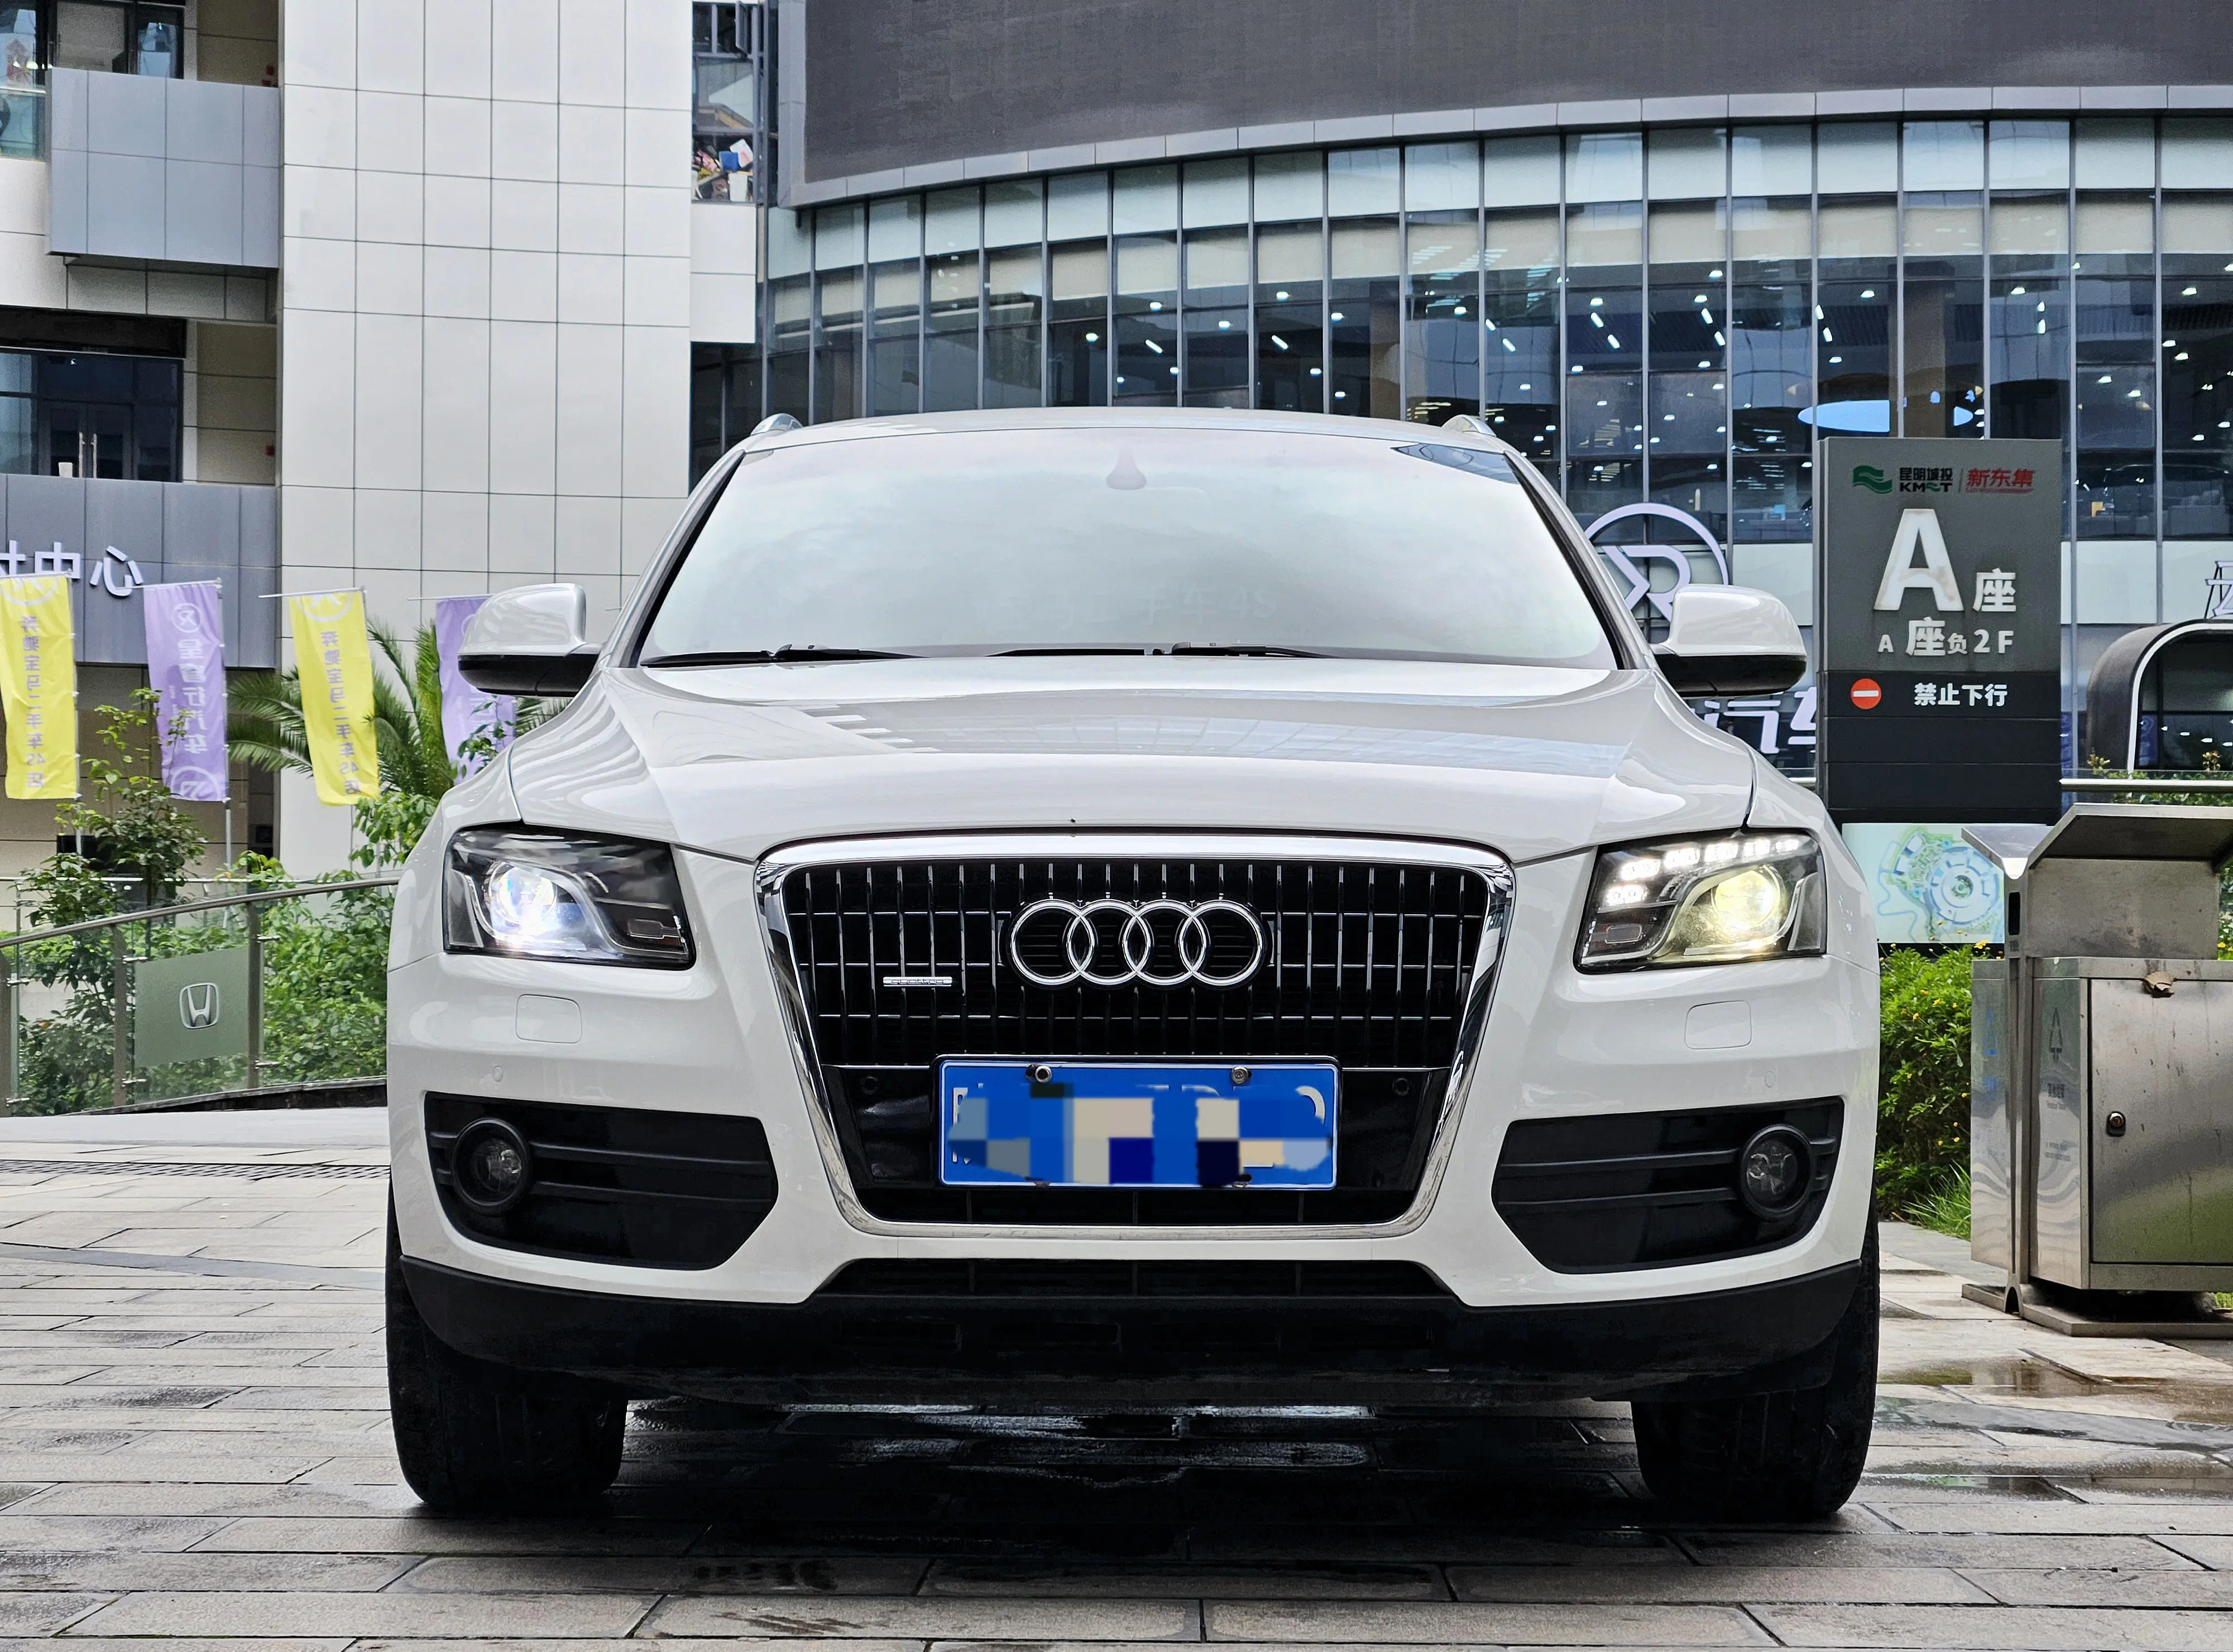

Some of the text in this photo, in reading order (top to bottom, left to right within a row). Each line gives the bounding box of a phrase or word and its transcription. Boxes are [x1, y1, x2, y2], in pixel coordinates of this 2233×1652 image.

[1899, 467, 1953, 482] 昆明城投
[1967, 468, 2035, 488] 新东集
[1914, 682, 2008, 707] 禁止下行
